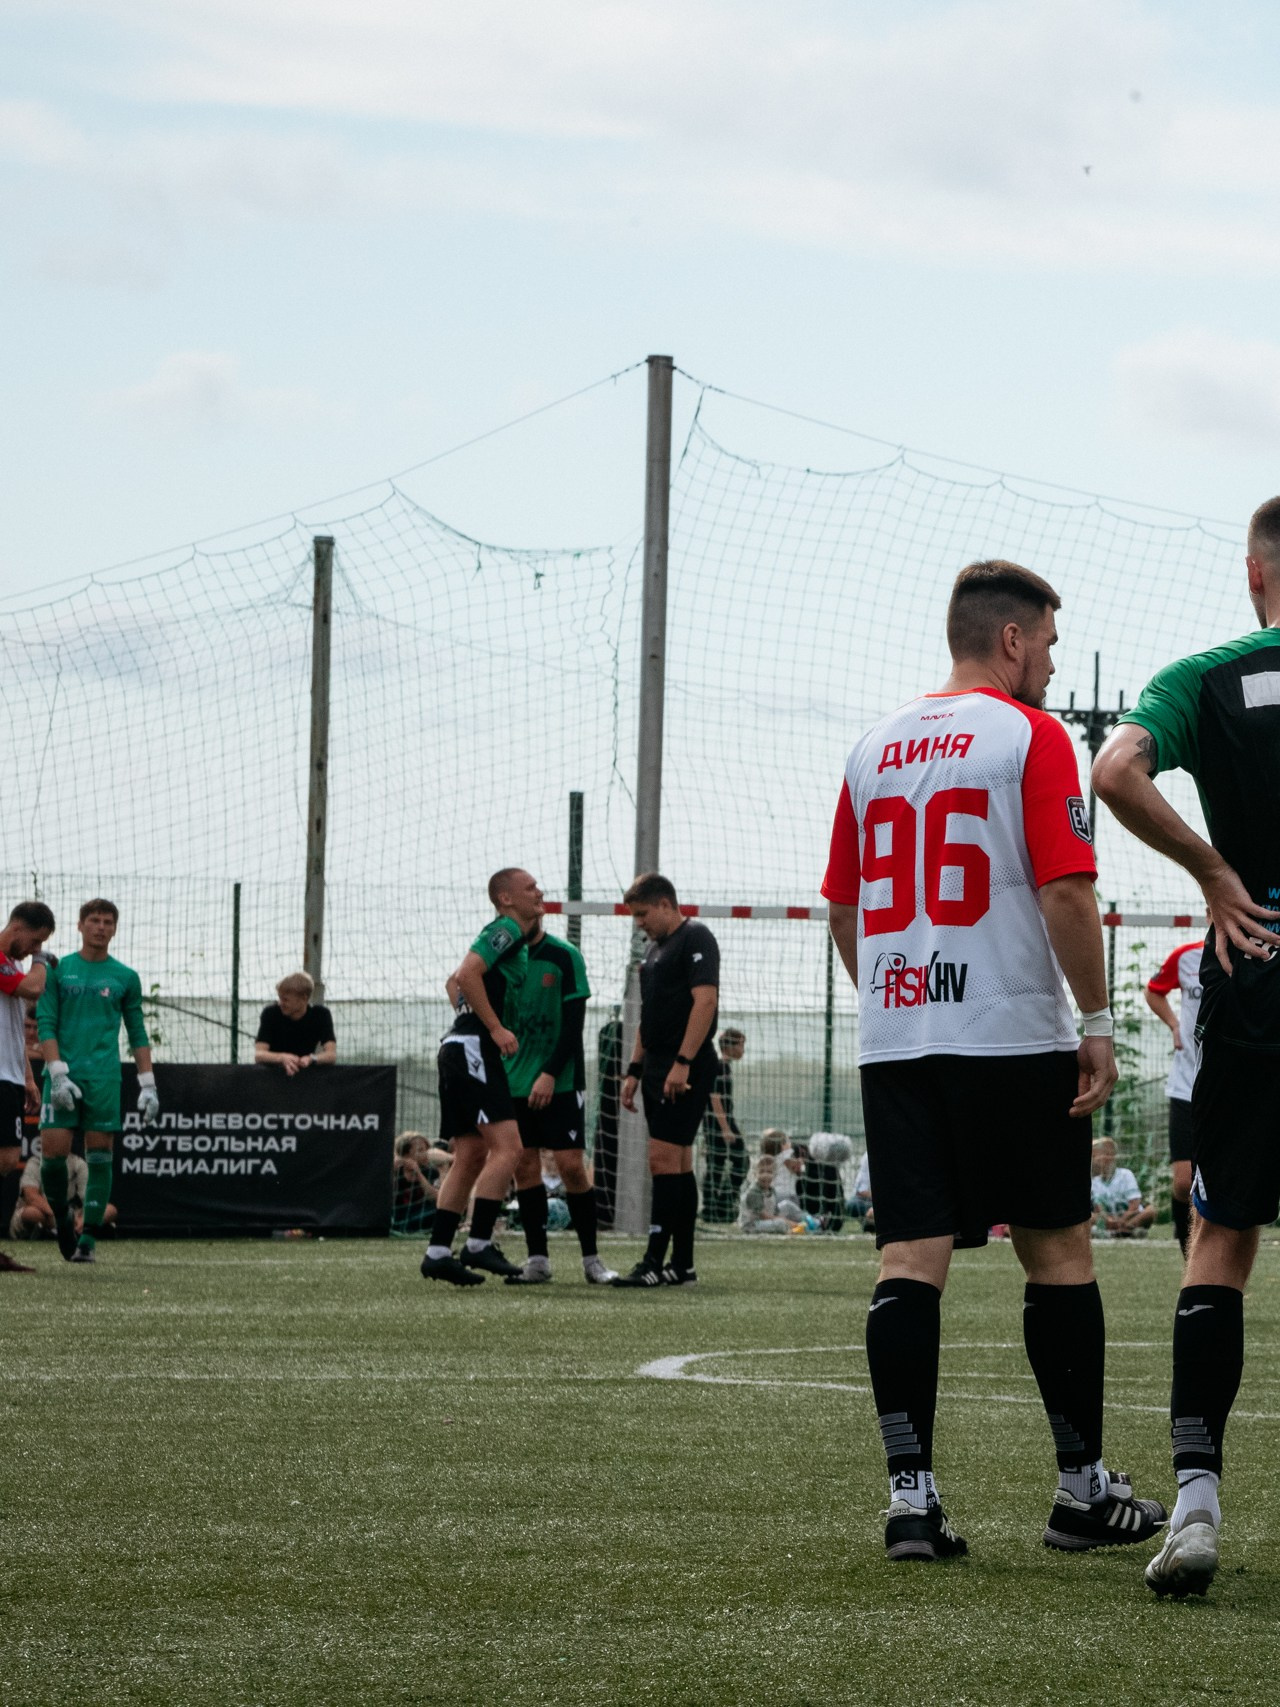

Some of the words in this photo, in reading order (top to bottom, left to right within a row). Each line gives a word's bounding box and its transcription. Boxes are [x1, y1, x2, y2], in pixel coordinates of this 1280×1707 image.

[877, 733, 976, 775] ДИНЯ
[861, 788, 991, 937] 96
[122, 1133, 297, 1152] ФУТБОЛЬНАЯ
[121, 1157, 278, 1177] МЕДИАЛИГА
